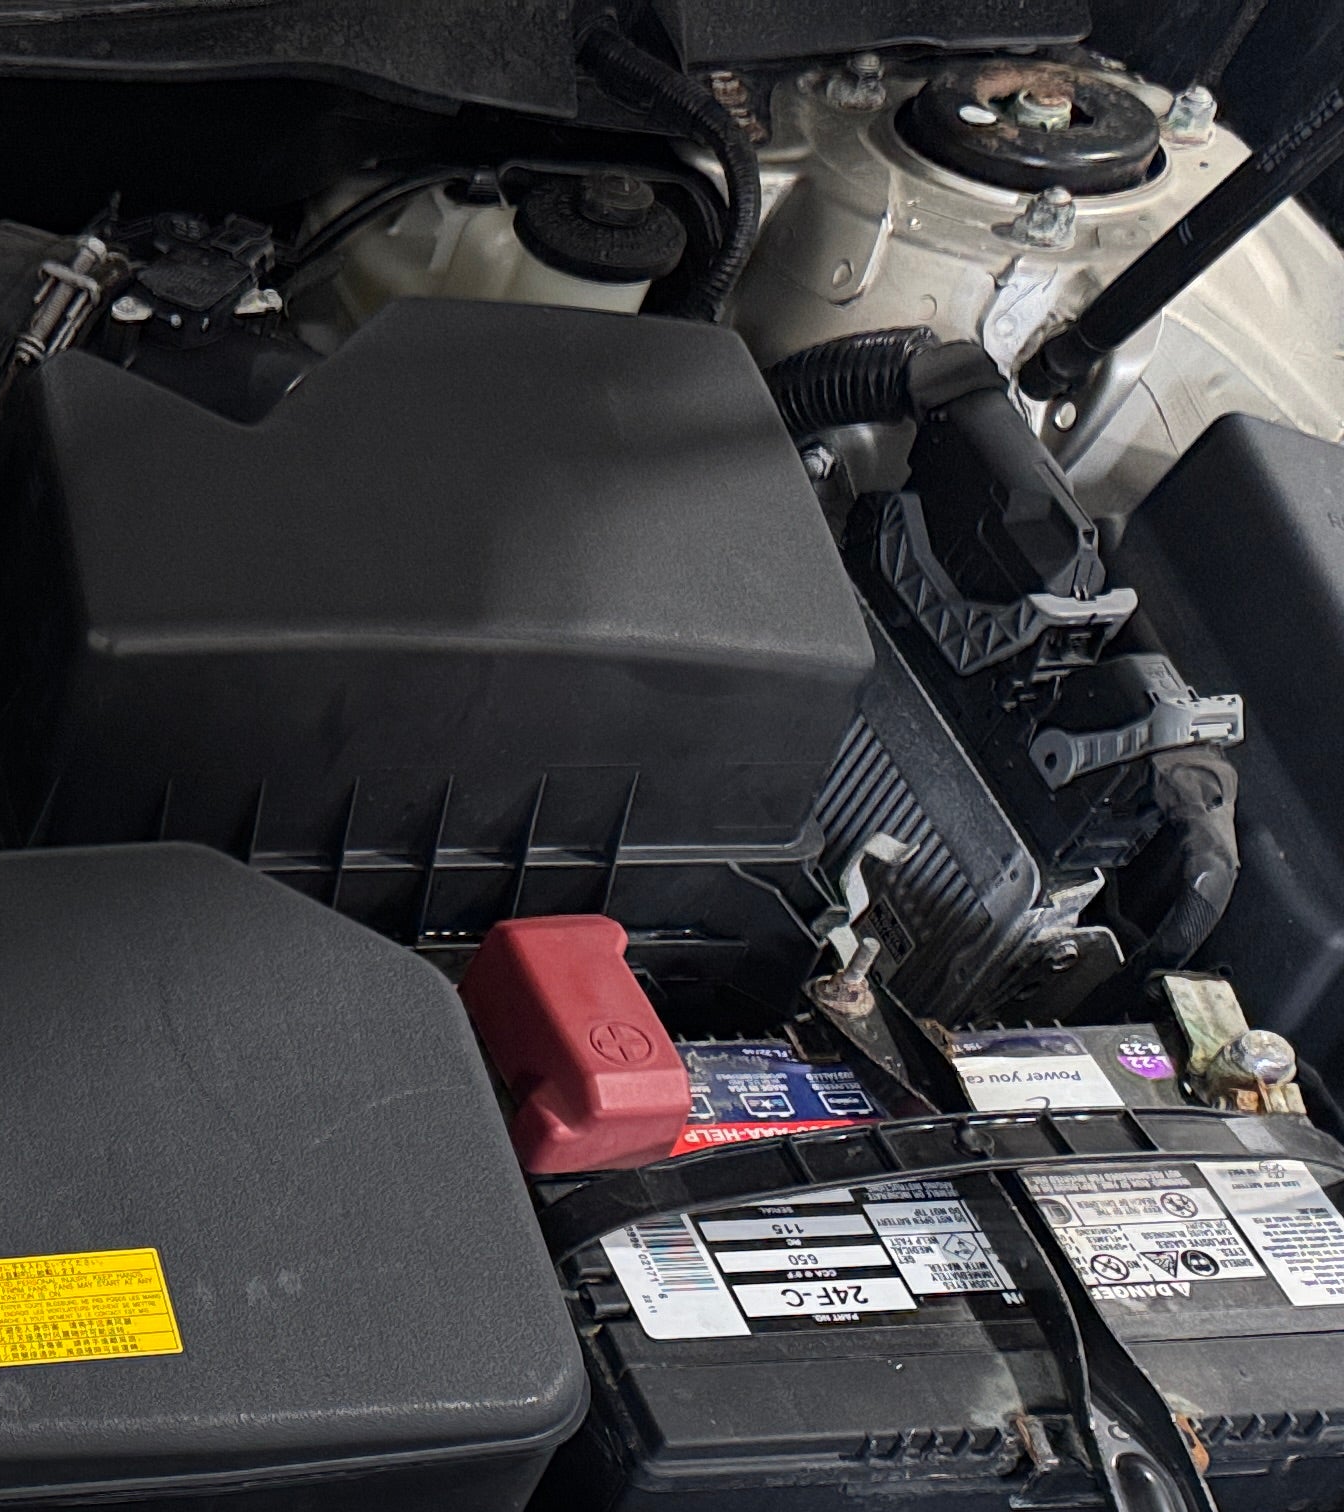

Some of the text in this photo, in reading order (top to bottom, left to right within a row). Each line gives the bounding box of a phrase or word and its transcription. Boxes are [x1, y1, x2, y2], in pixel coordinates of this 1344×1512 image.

[966, 1070, 1082, 1085] Power you ca
[876, 1218, 912, 1227] BATTERY
[771, 1222, 805, 1235] 115
[1187, 1236, 1240, 1247] EXPLOSIVE
[890, 1246, 934, 1256] MEDICAL
[787, 1253, 819, 1266] 650
[961, 1262, 988, 1271] WITH
[930, 1270, 995, 1282] IMMEDIATELY
[942, 1280, 1000, 1291] FLUSH EYES
[780, 1284, 869, 1308] 24F-C
